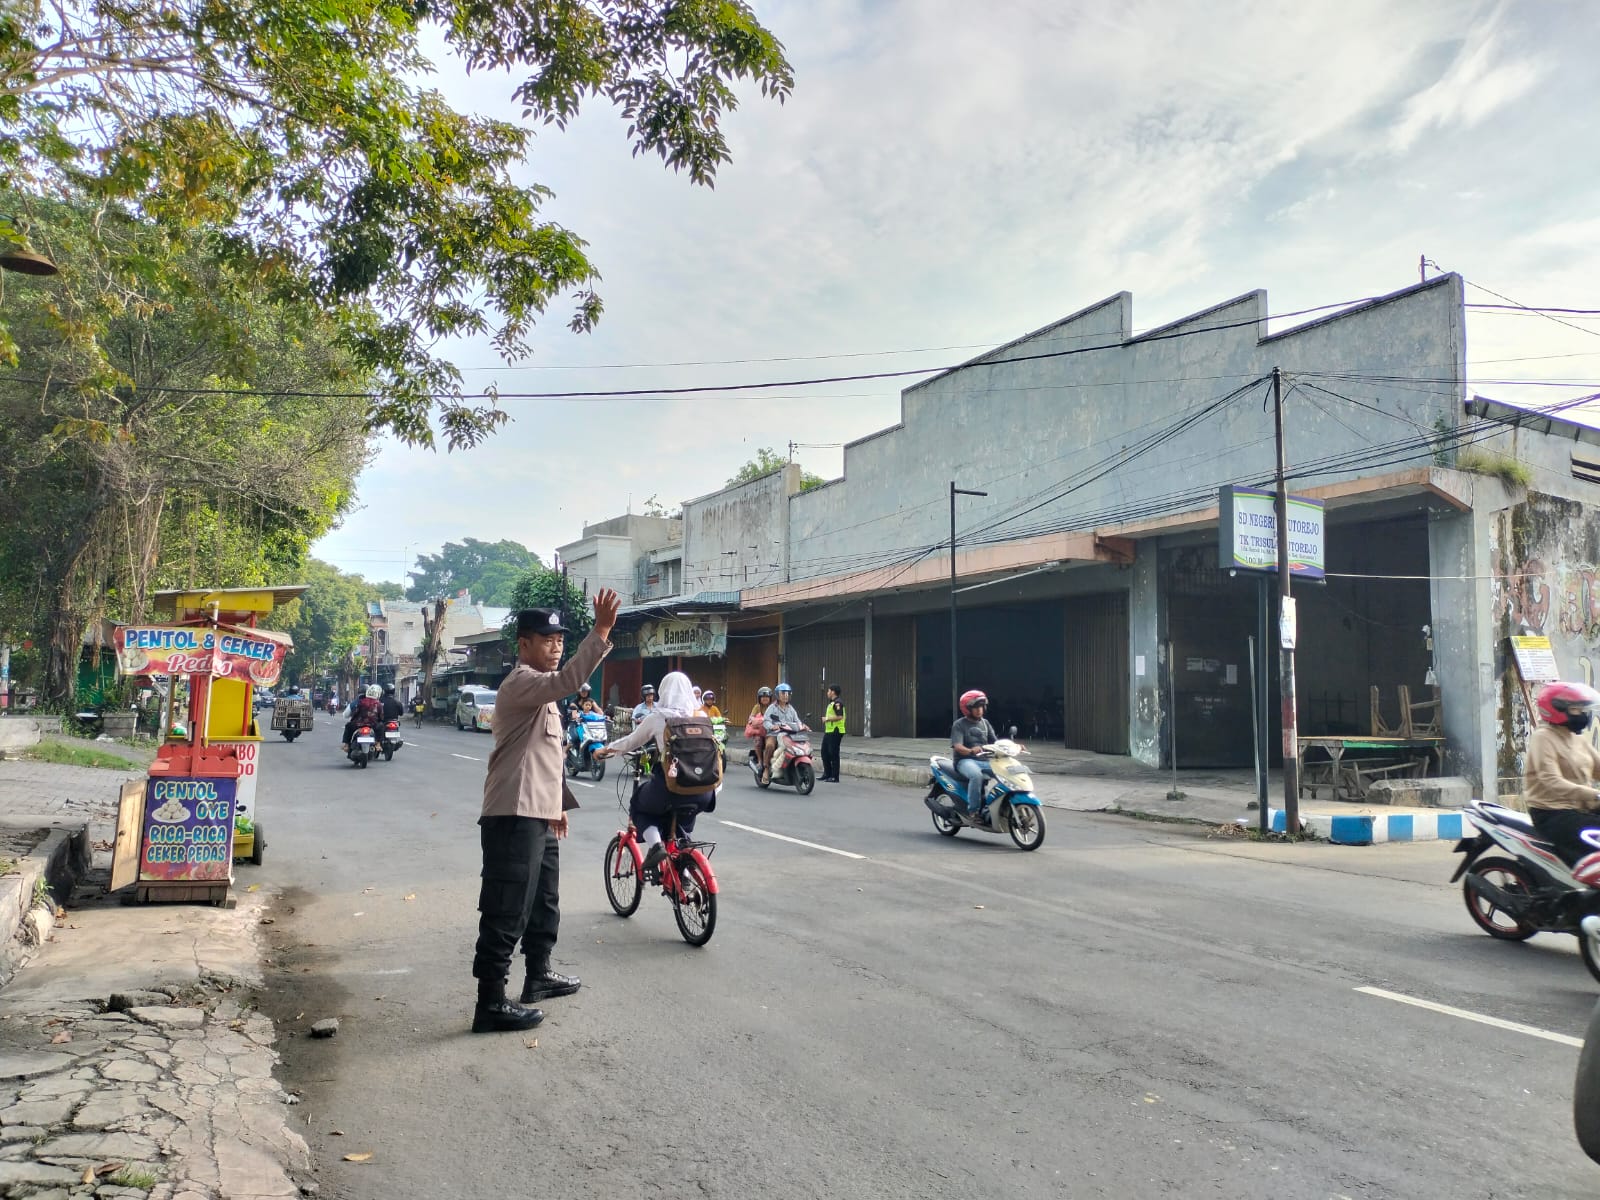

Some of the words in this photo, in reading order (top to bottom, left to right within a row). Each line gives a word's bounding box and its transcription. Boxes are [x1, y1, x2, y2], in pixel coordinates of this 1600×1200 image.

[1238, 512, 1247, 525] SD
[1249, 513, 1275, 529] NEGERI
[1288, 519, 1319, 536] UTOREJO
[1240, 534, 1249, 546] TK
[1251, 536, 1276, 549] TRISUL
[125, 629, 198, 649] PENTOL
[203, 634, 214, 649] &
[220, 635, 275, 661] CEKER
[154, 781, 217, 800] PENTOL
[195, 801, 229, 819] OYE
[149, 825, 227, 844] RICA-RICA
[147, 845, 186, 863] CEKER
[187, 845, 227, 862] PEDAS
